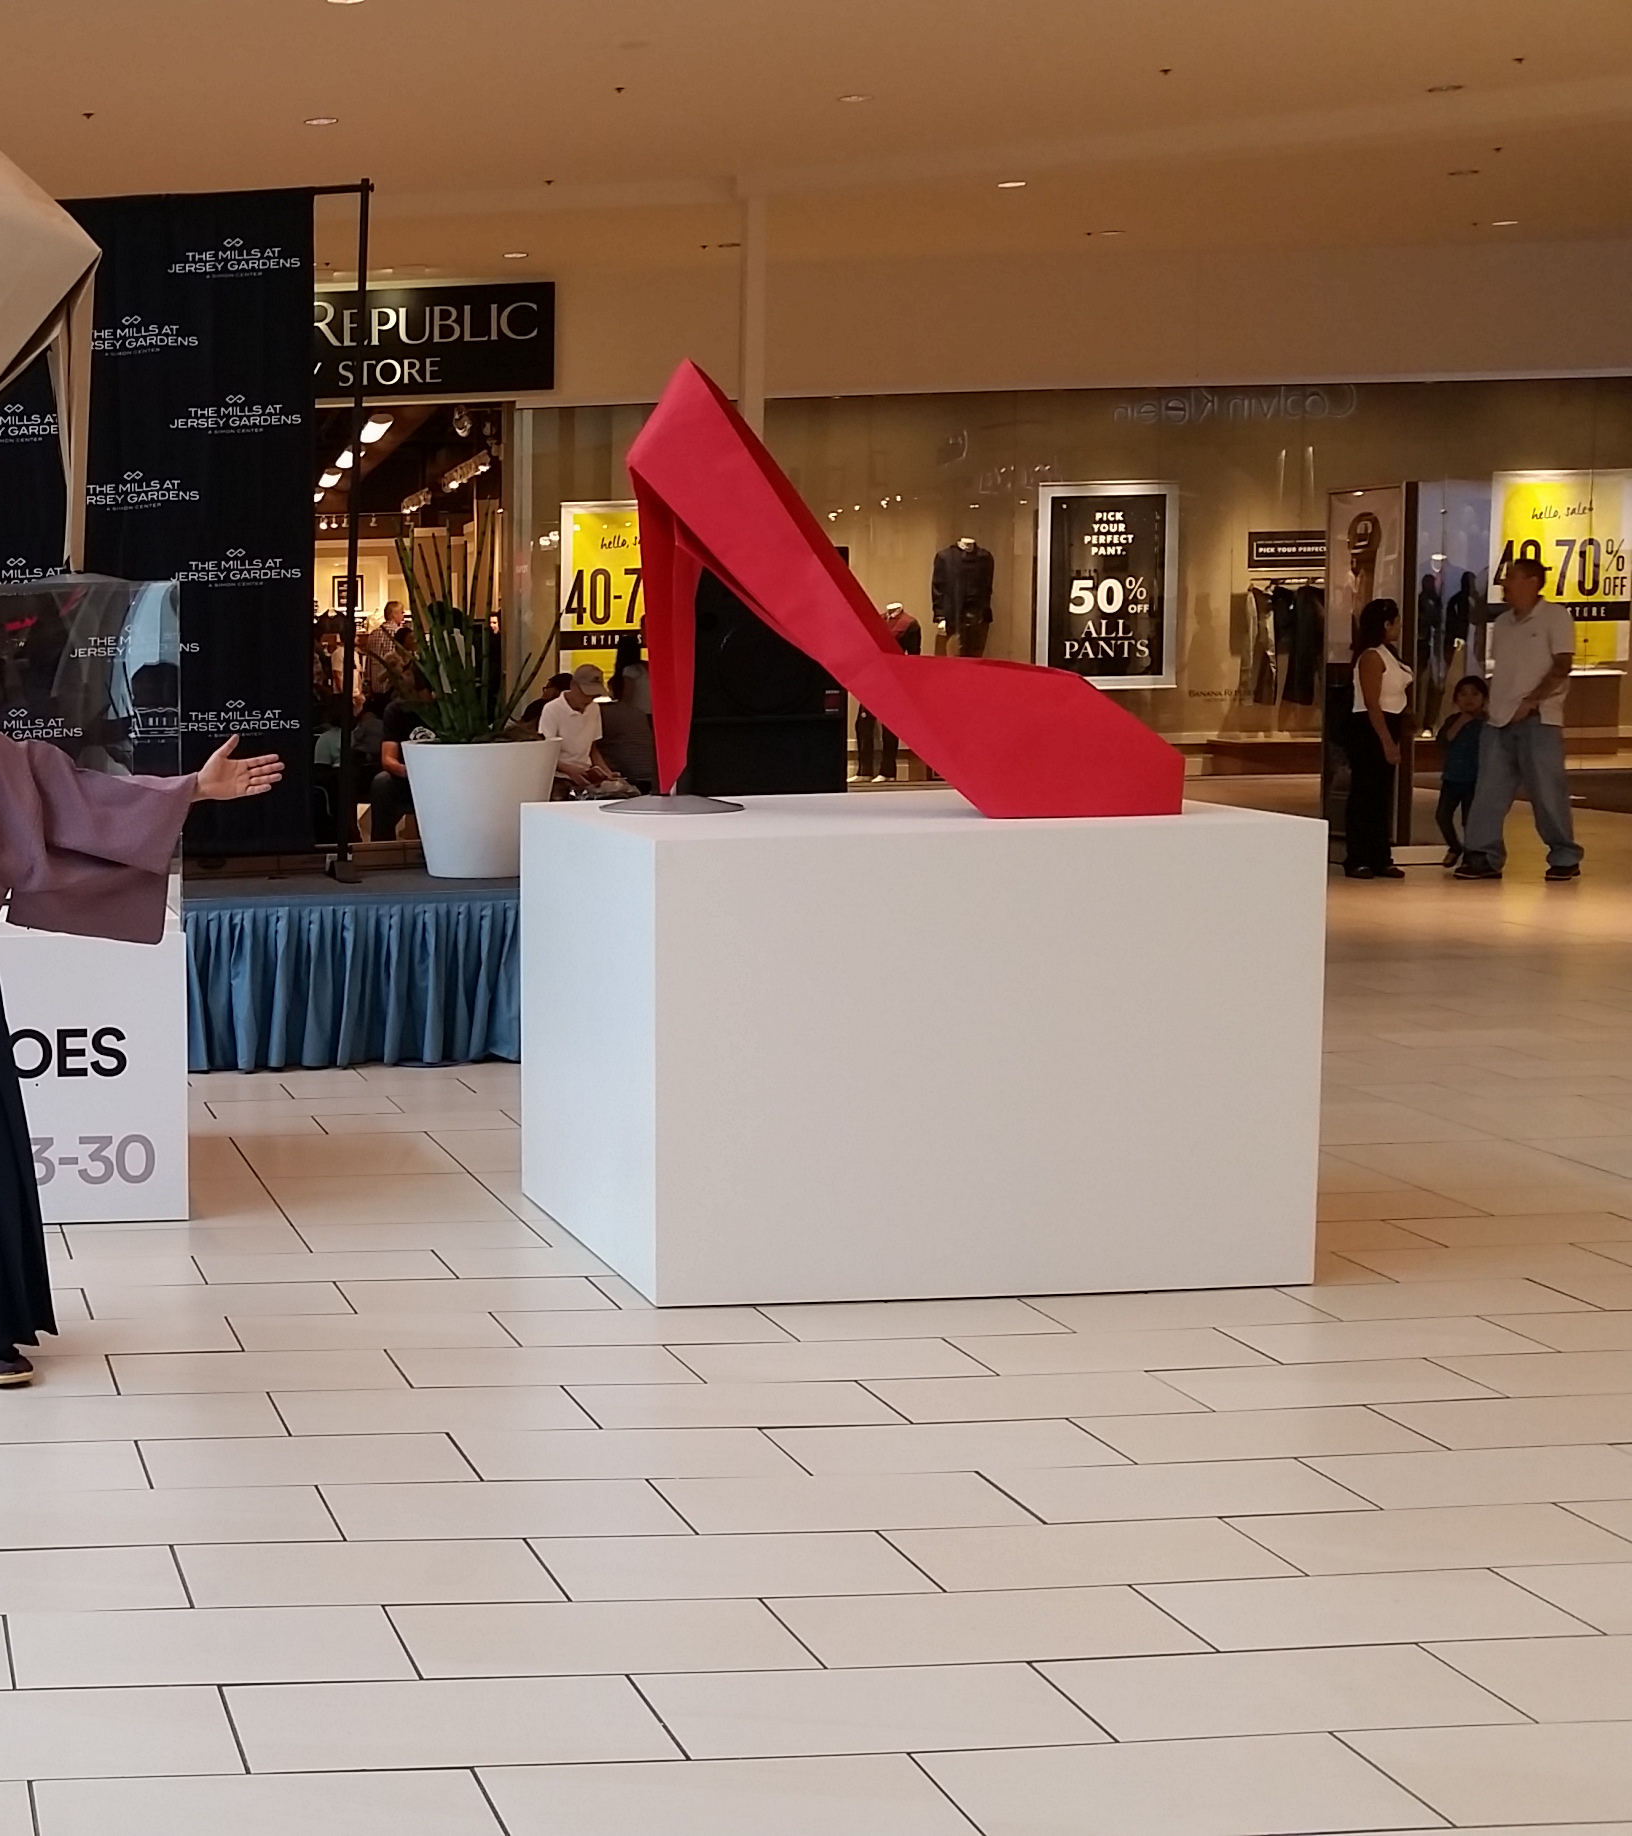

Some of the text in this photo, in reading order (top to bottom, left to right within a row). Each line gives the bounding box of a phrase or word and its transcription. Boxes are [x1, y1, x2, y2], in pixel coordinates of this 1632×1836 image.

[186, 248, 281, 261] THE MILLS AT
[168, 258, 300, 273] JERSEY GARDENS
[314, 302, 539, 347] REPUBLIC
[92, 325, 179, 338] HE MILLS AT
[126, 336, 198, 348] GARDENS
[338, 357, 443, 387] STORE
[188, 405, 282, 417] THE MILLS AT
[0, 415, 40, 425] MILLS
[170, 415, 301, 428] JERSEY GARDENS
[8, 425, 58, 435] GARDE
[87, 480, 180, 494] THE MILLS AT
[87, 491, 199, 505] RSEY GARDENS
[1095, 511, 1124, 521] PICK
[1531, 505, 1561, 519] hello,
[1092, 523, 1126, 533] YOUR
[601, 534, 631, 550] hello,
[1084, 534, 1134, 544] PERFECT
[1091, 546, 1126, 556] PANT.
[189, 559, 283, 570] THE MILLS AT
[2, 568, 42, 578] MILLS
[46, 568, 63, 577] AT
[170, 569, 301, 581] JERSEY GARDENS
[1603, 576, 1627, 596] OFF
[1068, 576, 1149, 614] 50% OFF
[1081, 619, 1133, 638] ALL
[88, 637, 116, 646] THE
[70, 647, 125, 658] JERSEY
[1064, 639, 1149, 659] PANTS
[189, 710, 281, 720] THE MILLS AT
[4, 719, 44, 729] MILLS
[48, 718, 64, 727] AT
[230, 720, 300, 730] GARDENS
[12, 728, 83, 739] GARDENS
[10, 1027, 128, 1079] OES
